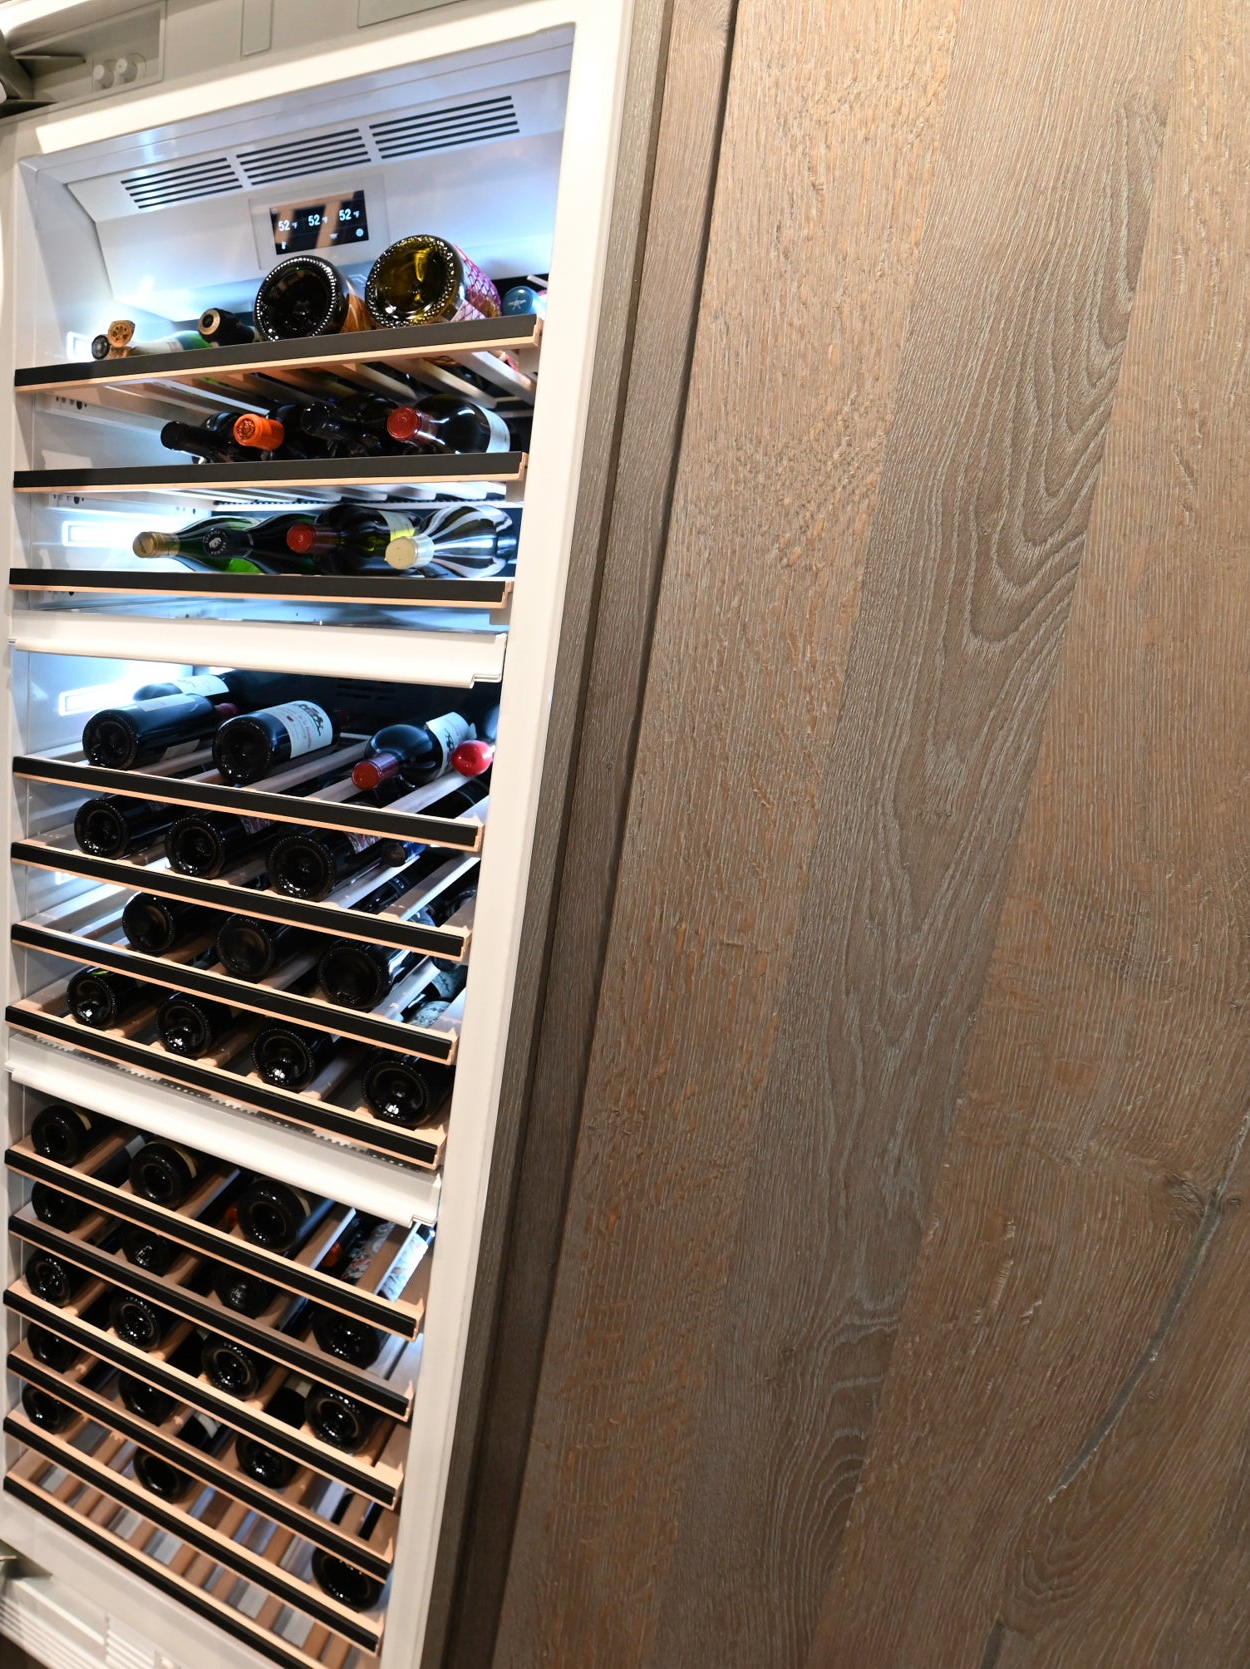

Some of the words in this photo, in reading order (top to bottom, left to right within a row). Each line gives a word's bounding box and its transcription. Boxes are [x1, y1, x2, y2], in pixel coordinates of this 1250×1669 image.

[278, 219, 290, 231] 52
[308, 214, 320, 227] 52
[339, 208, 352, 221] 52
